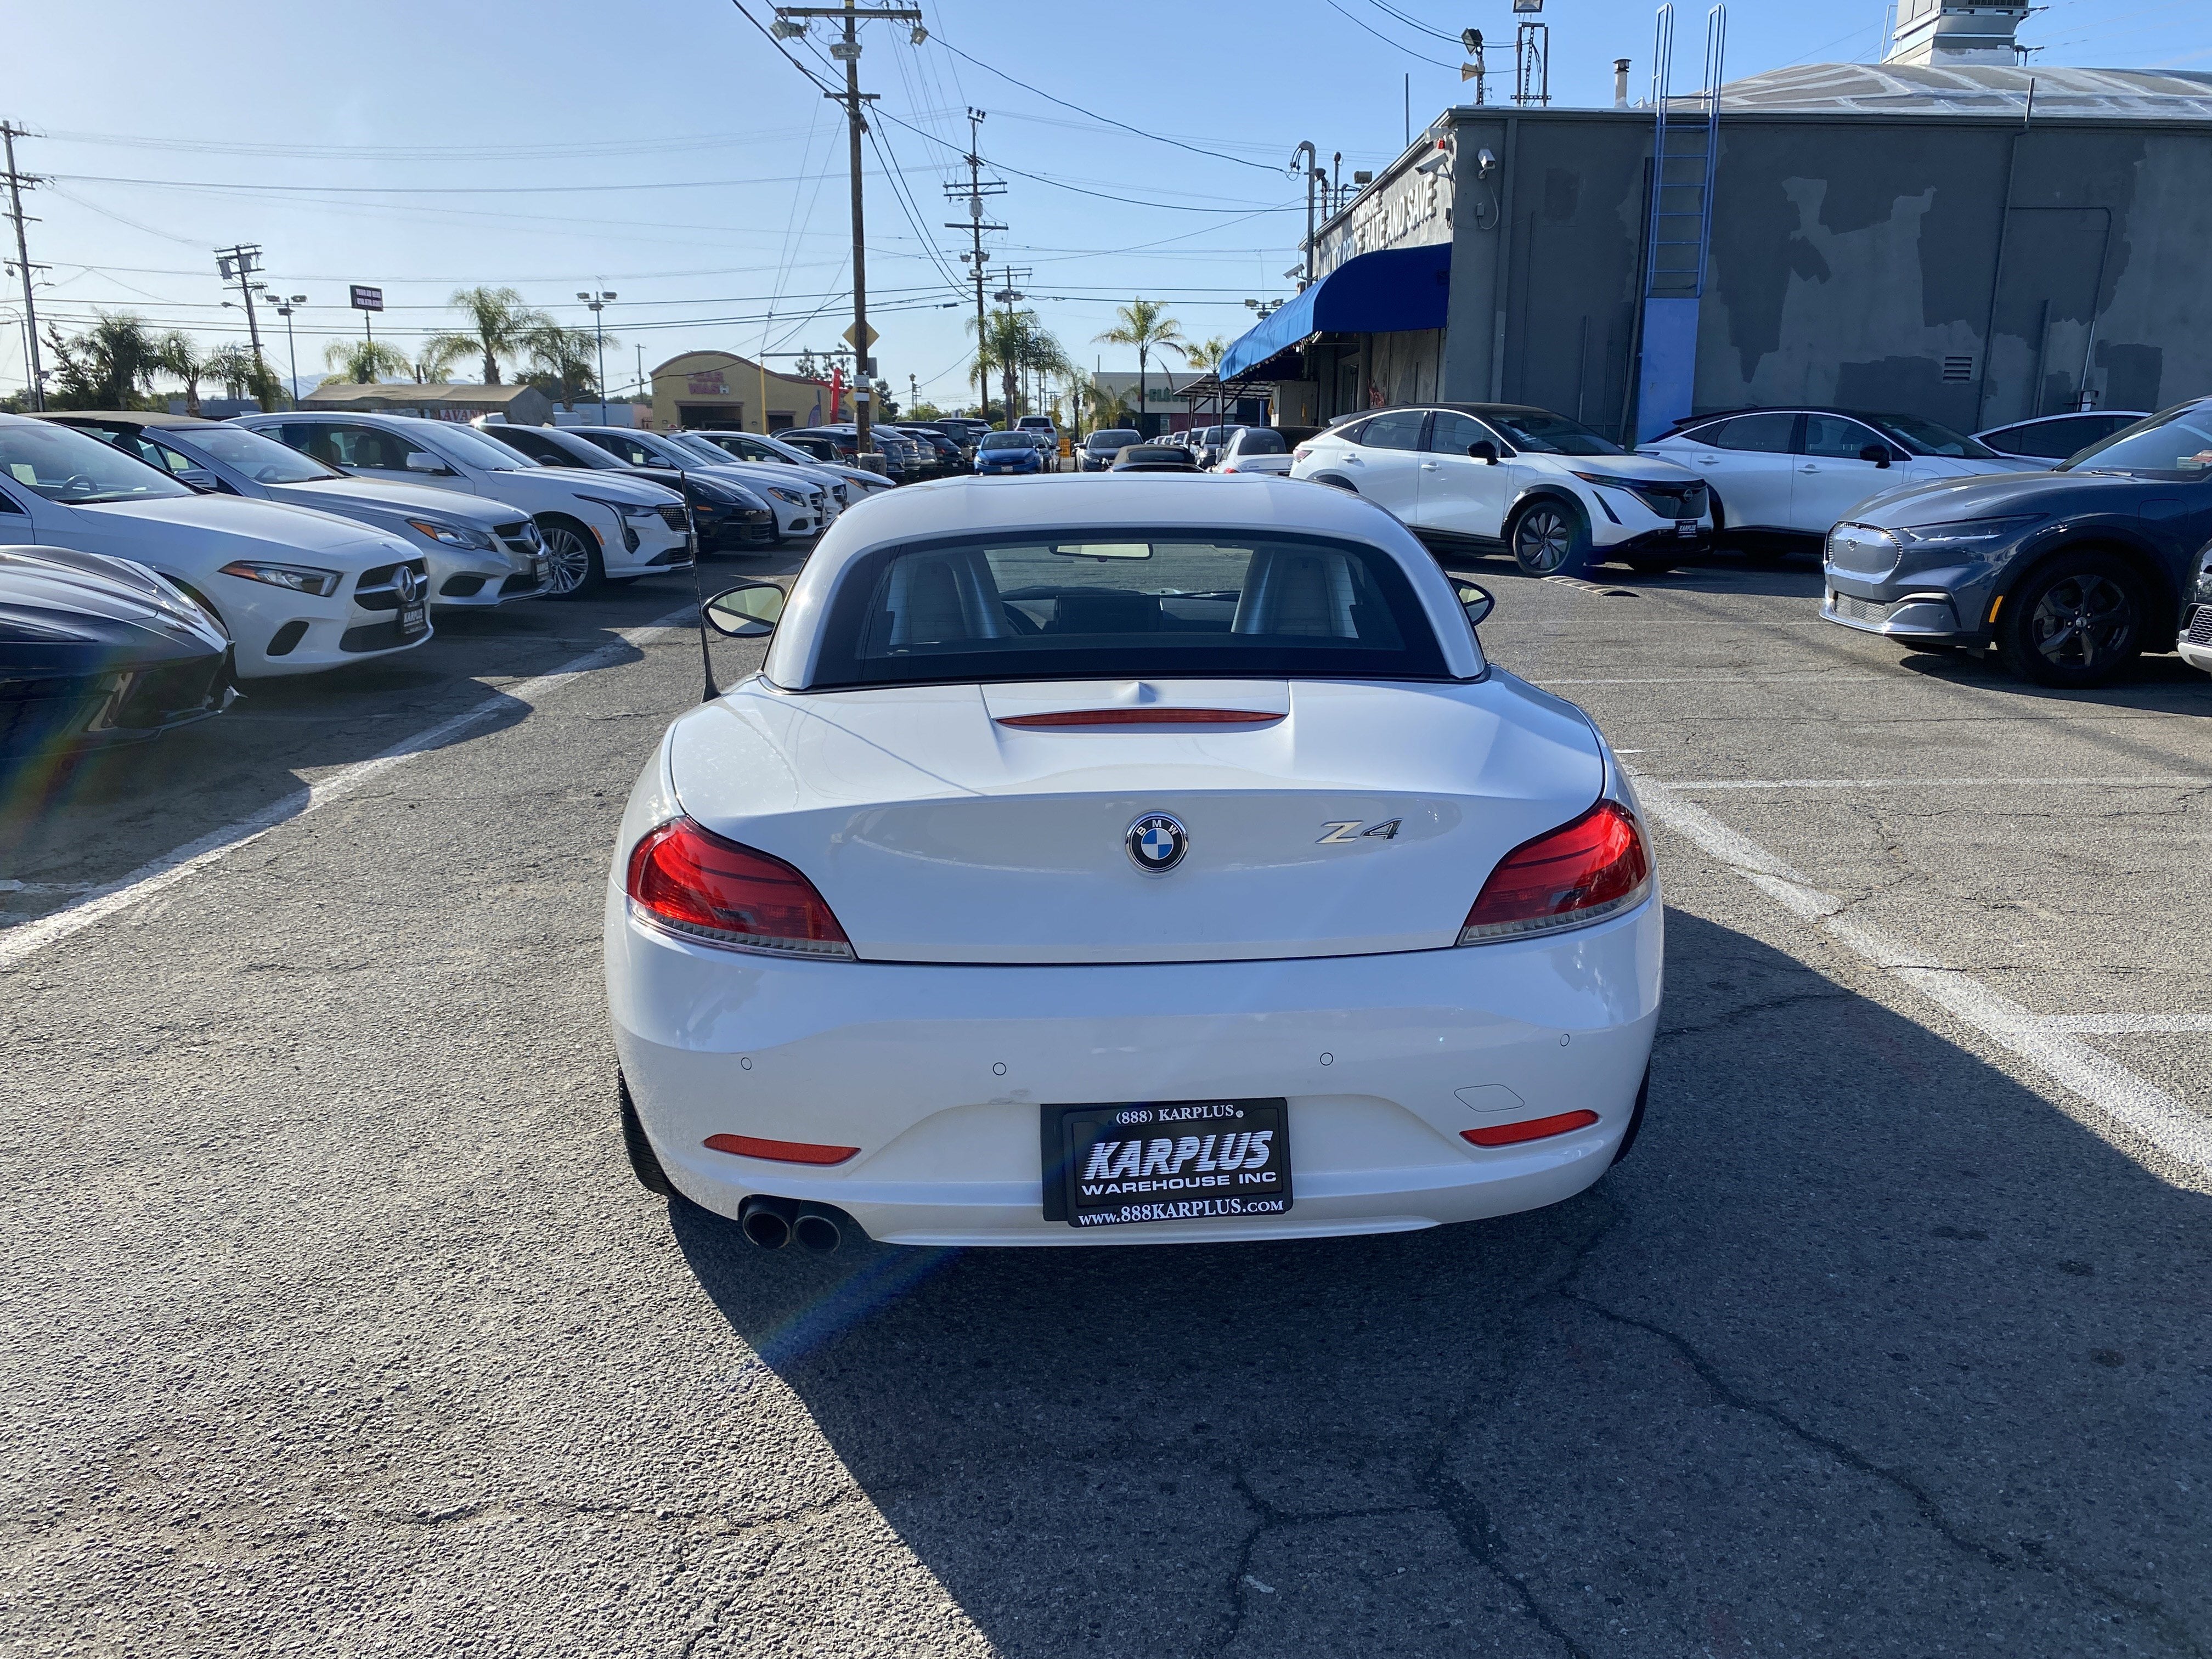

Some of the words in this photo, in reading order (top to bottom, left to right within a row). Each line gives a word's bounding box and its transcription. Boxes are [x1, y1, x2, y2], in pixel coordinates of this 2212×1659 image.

[1351, 190, 1380, 231] COMPARE
[1365, 210, 1386, 253] RATE
[1386, 195, 1406, 244] AND
[1406, 171, 1434, 229] SAVE
[689, 383, 730, 394] WASH
[1136, 820, 1179, 837] BMW
[1315, 817, 1403, 844] Z4
[1116, 1110, 1153, 1125] (888)
[1159, 1104, 1234, 1121] KARPLUS
[1081, 1131, 1273, 1180] KARPLUS
[1081, 1175, 1231, 1195] WAREHOUSE
[1239, 1171, 1277, 1184] INC
